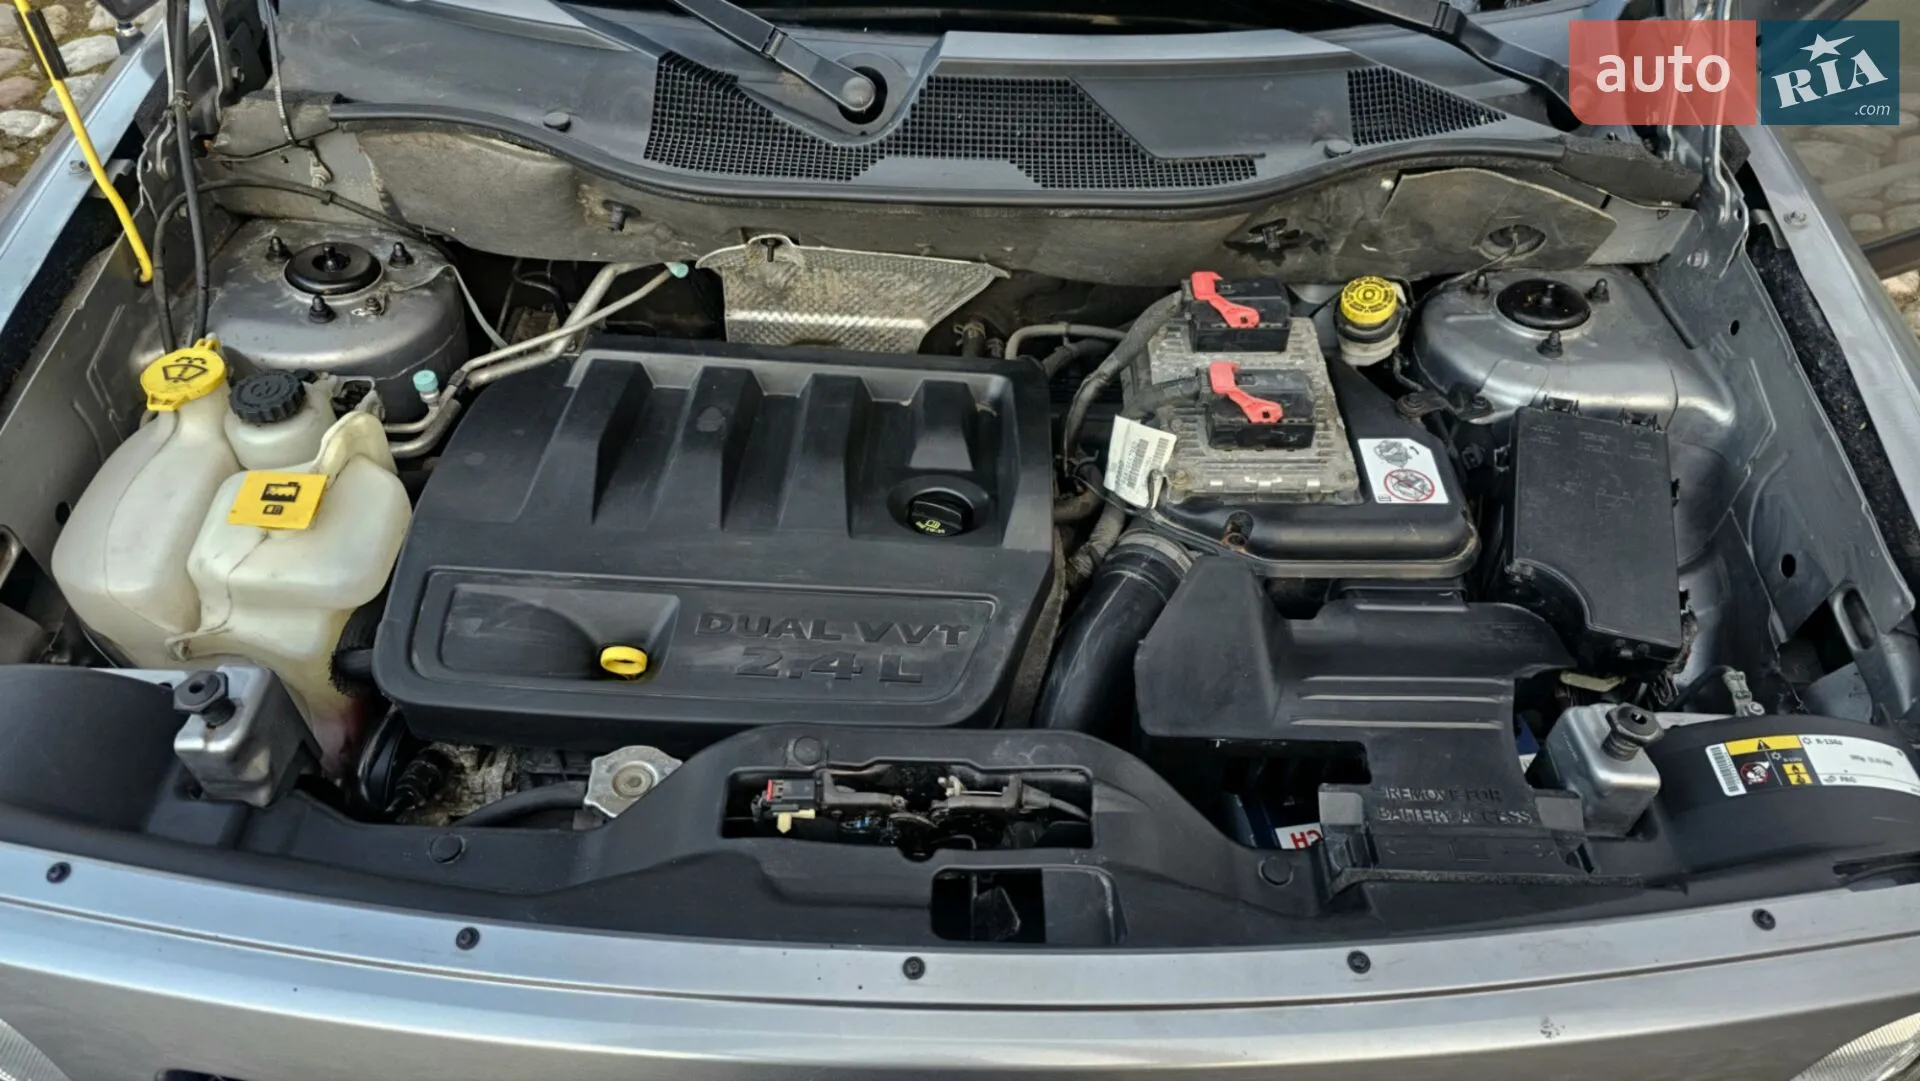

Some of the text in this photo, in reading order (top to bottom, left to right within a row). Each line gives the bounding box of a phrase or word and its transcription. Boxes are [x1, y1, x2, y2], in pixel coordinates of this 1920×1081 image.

[695, 612, 970, 647] DUAL VVT
[1384, 786, 1502, 803] REMOVE FOR
[1376, 807, 1533, 825] BATTERY ACCESS
